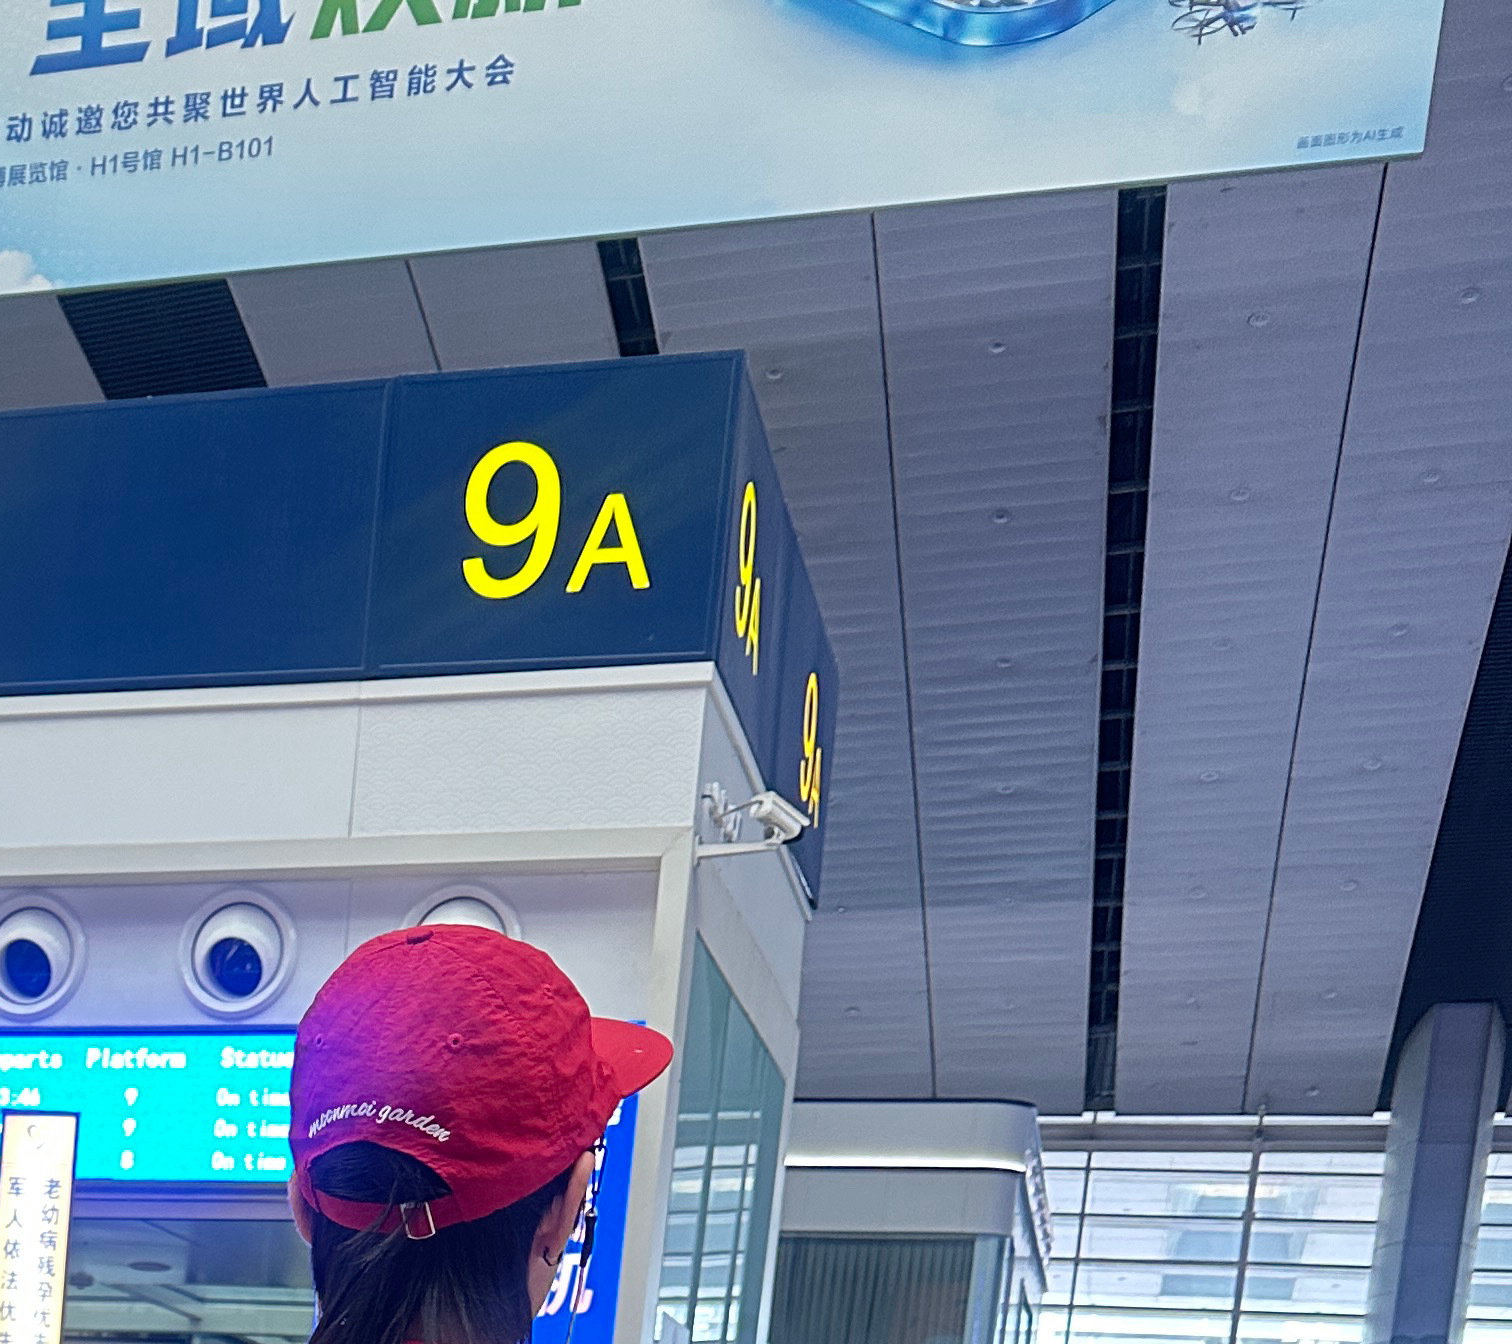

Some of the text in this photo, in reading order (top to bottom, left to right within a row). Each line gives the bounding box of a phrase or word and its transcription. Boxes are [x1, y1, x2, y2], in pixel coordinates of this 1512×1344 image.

[90, 146, 163, 177] H1号馆
[171, 135, 276, 168] H1-B101
[462, 440, 650, 600] 9A
[735, 482, 761, 676] 9A
[86, 1047, 187, 1069] Platform
[376, 1104, 451, 1142] garden
